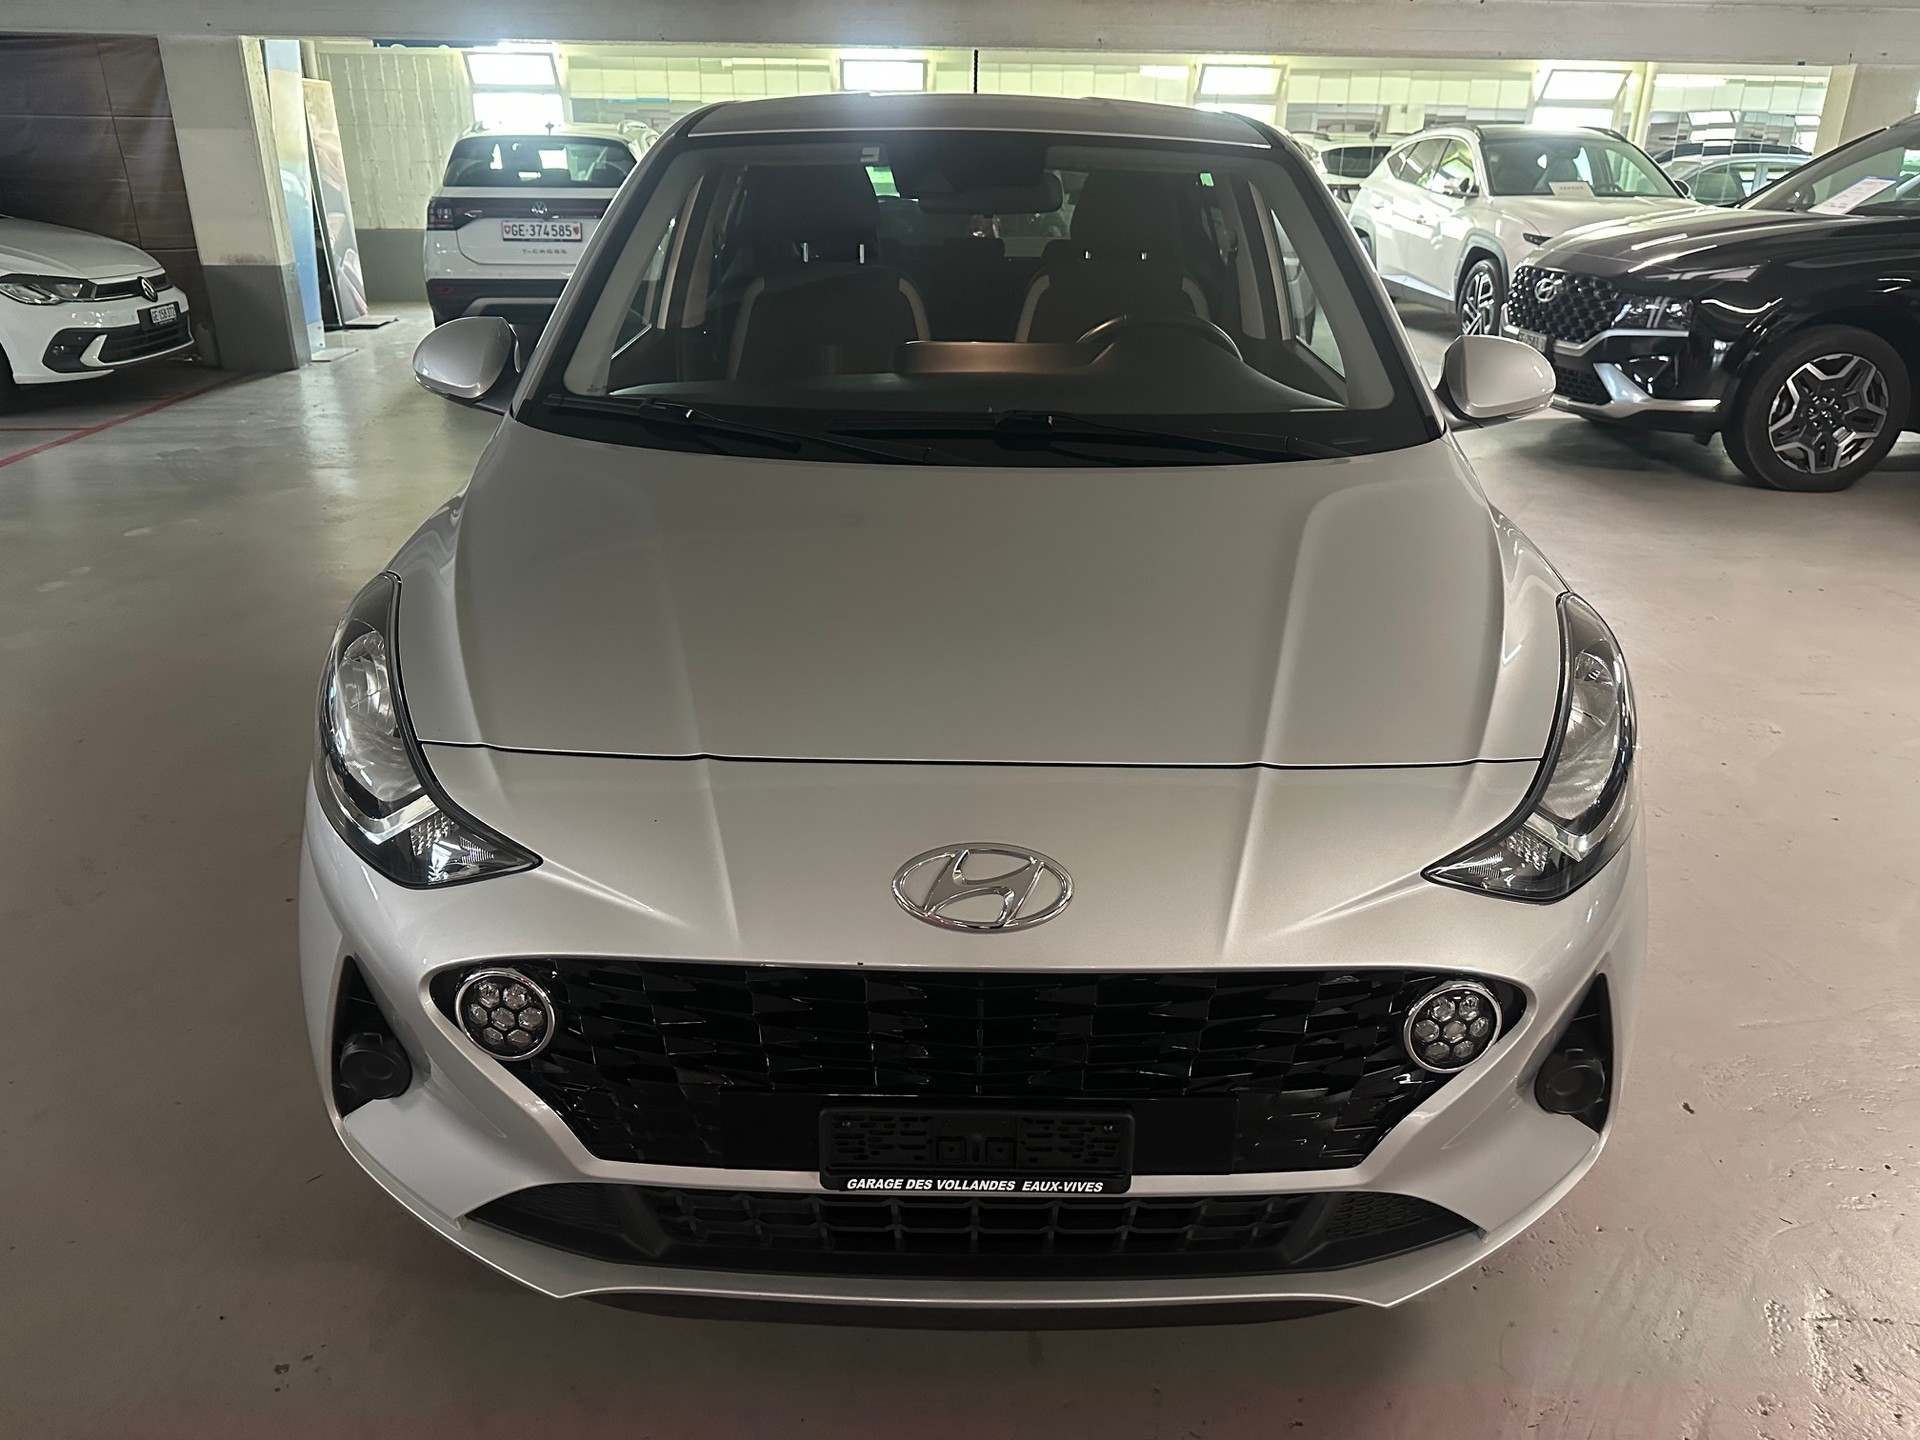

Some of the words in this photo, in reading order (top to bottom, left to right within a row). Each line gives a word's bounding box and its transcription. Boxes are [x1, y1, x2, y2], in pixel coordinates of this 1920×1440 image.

[846, 1178, 904, 1190] GARAGE
[905, 1179, 933, 1191] DES
[936, 1179, 1016, 1192] VOLLANDES
[1022, 1181, 1104, 1193] EAUX-VIVES
